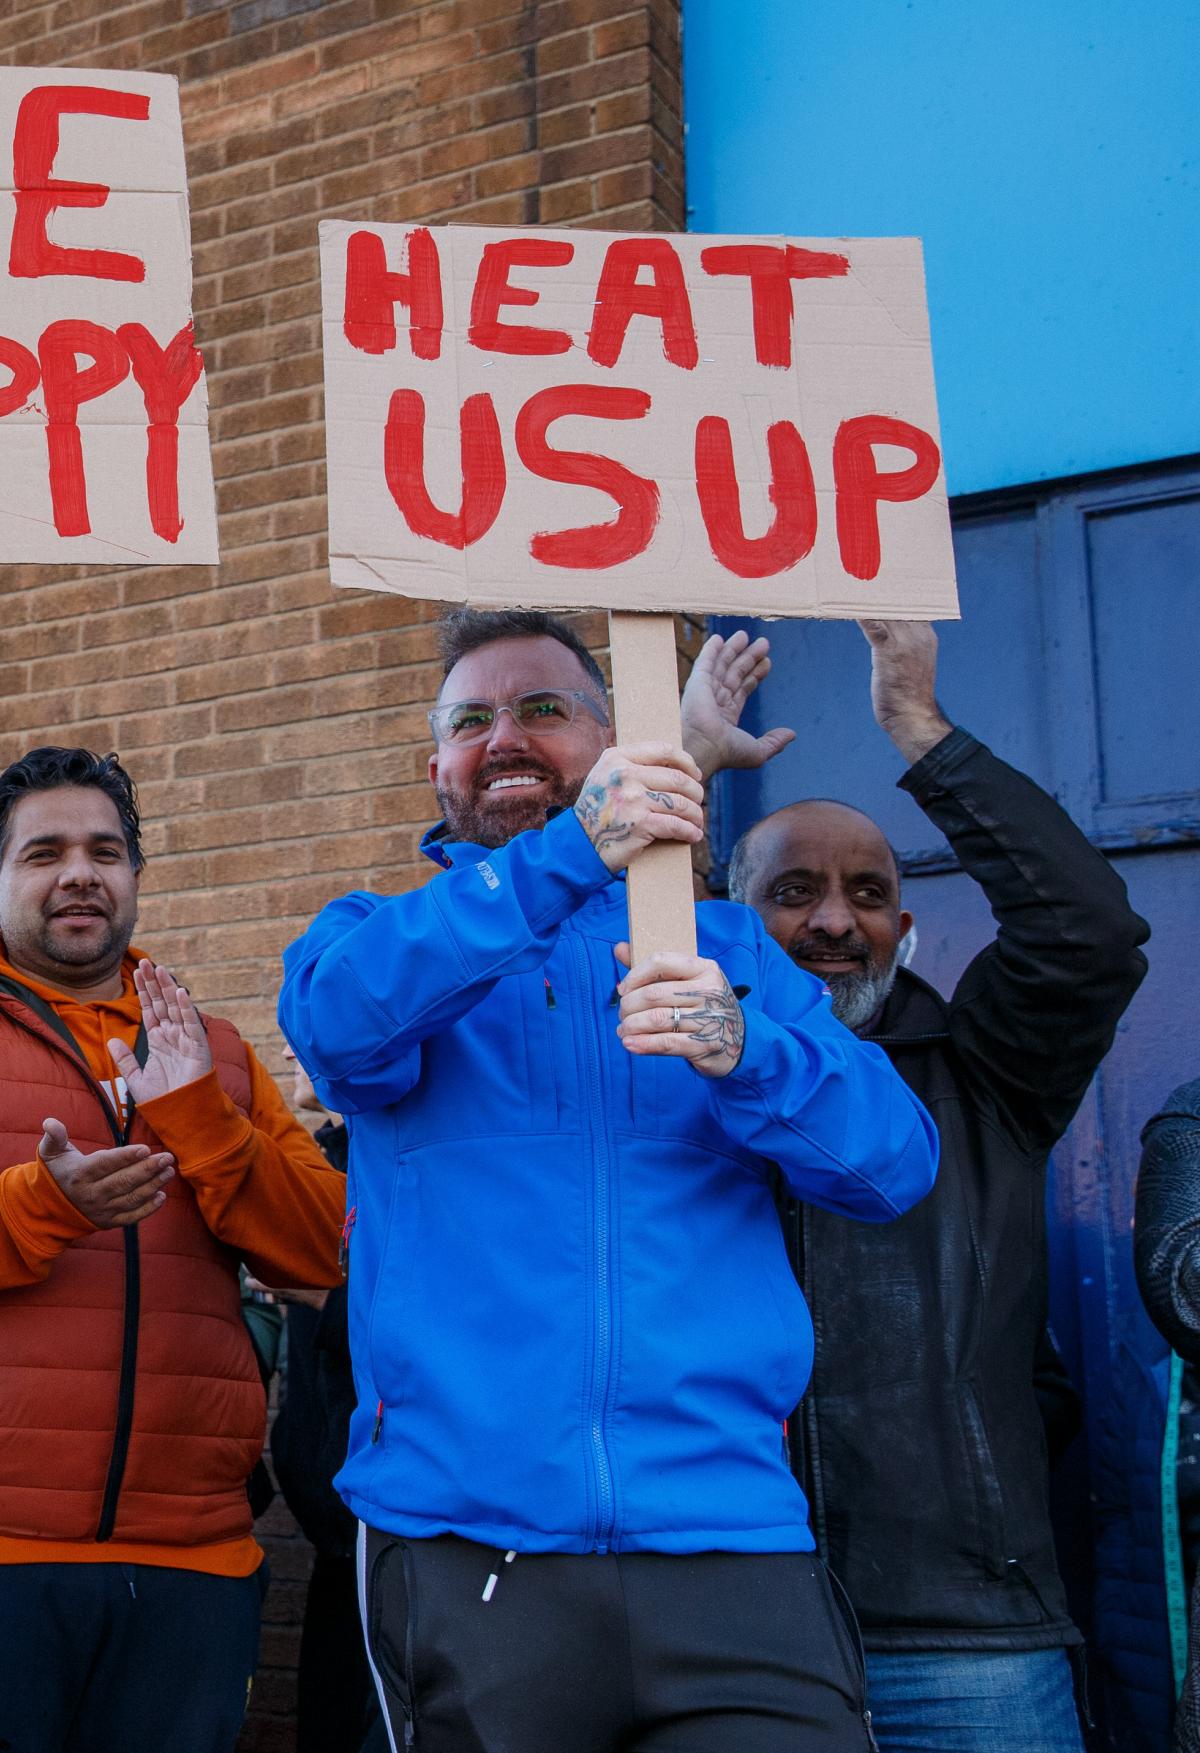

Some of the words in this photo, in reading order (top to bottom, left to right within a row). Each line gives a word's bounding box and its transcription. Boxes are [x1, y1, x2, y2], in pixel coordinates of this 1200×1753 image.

[343, 227, 851, 371] HEAT
[384, 384, 661, 570] US
[695, 413, 941, 581] UP
